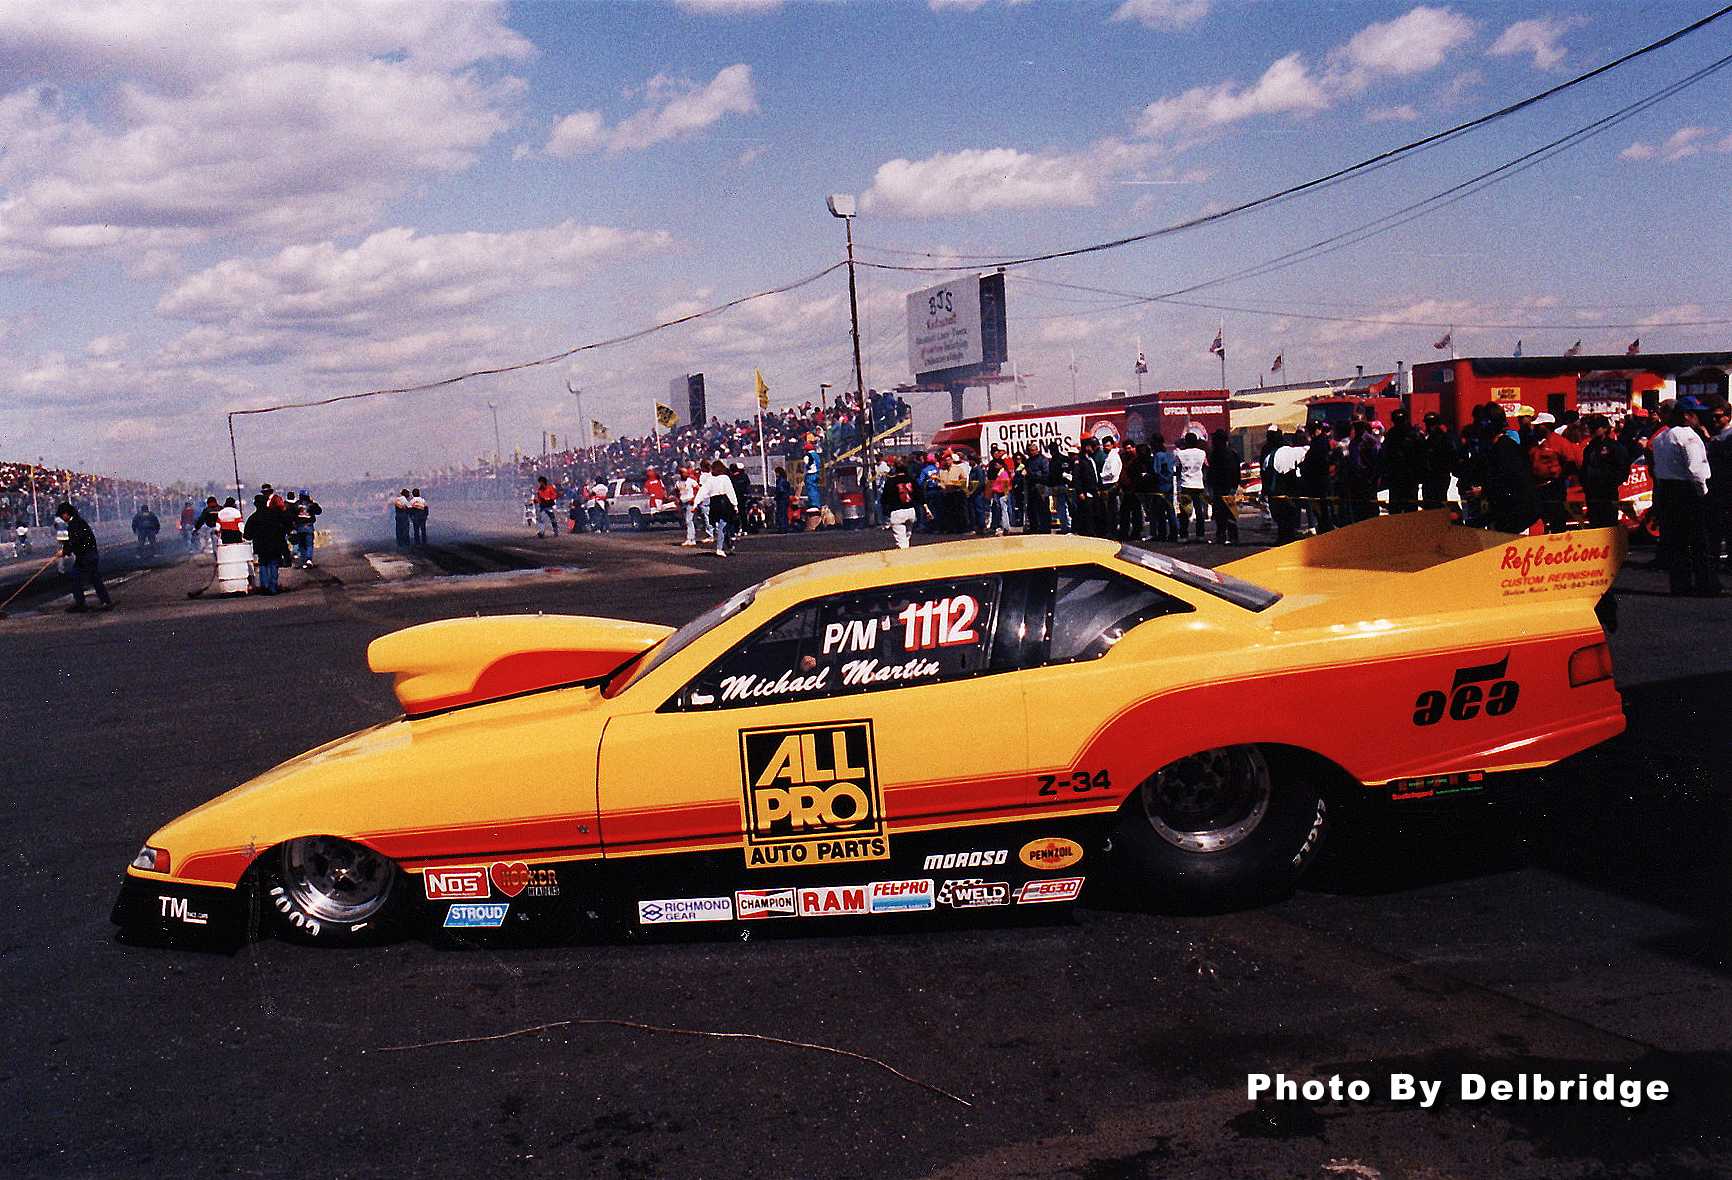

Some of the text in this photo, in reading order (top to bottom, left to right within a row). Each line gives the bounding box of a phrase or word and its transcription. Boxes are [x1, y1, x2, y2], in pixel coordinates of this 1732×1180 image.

[1000, 421, 1062, 441] OFFICIAL
[1501, 545, 1610, 577] Reflections
[1501, 576, 1544, 588] CUSTOM
[822, 594, 979, 654] P/M 1112
[720, 657, 940, 701] Michael Martin
[755, 731, 865, 787] ALL
[1038, 769, 1111, 796] Z-34
[755, 782, 869, 830] PRO
[751, 838, 886, 866] AUTO PARTS
[923, 850, 1008, 870] MOROSO
[1029, 846, 1074, 861] PENNZOIL
[428, 872, 479, 893] NOS
[500, 868, 558, 886] HOOKER
[741, 897, 792, 909] CHAMPION
[803, 889, 864, 912] RAM
[954, 886, 1006, 901] WELD
[451, 907, 503, 919] STROUD
[664, 899, 730, 912] RICHMOND
[665, 911, 697, 920] GEAR
